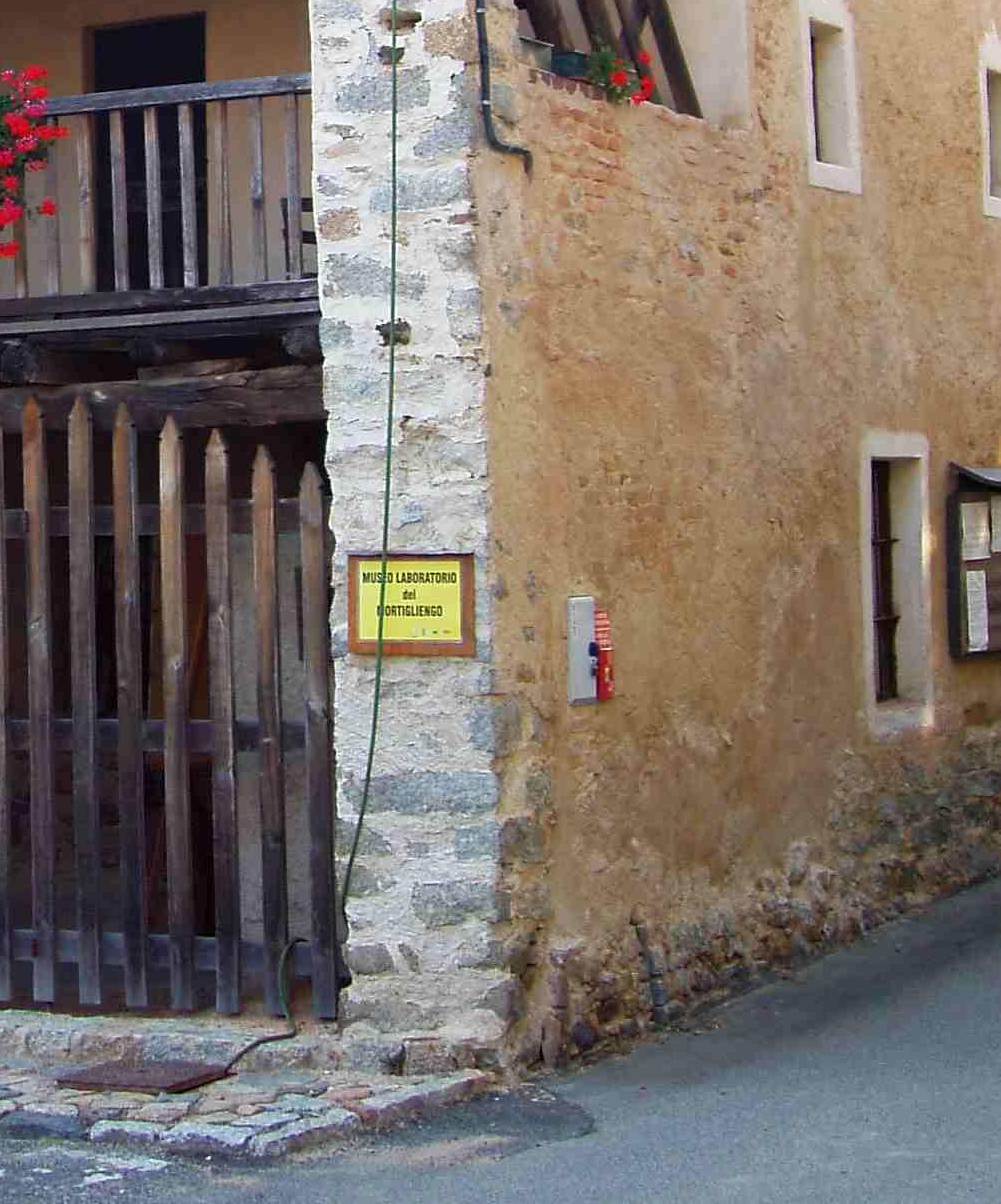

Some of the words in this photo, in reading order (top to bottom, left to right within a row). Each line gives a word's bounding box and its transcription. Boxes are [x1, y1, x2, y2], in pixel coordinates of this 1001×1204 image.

[363, 572, 393, 583] MUSO
[396, 572, 457, 583] LABORATORIO
[402, 589, 416, 600] del
